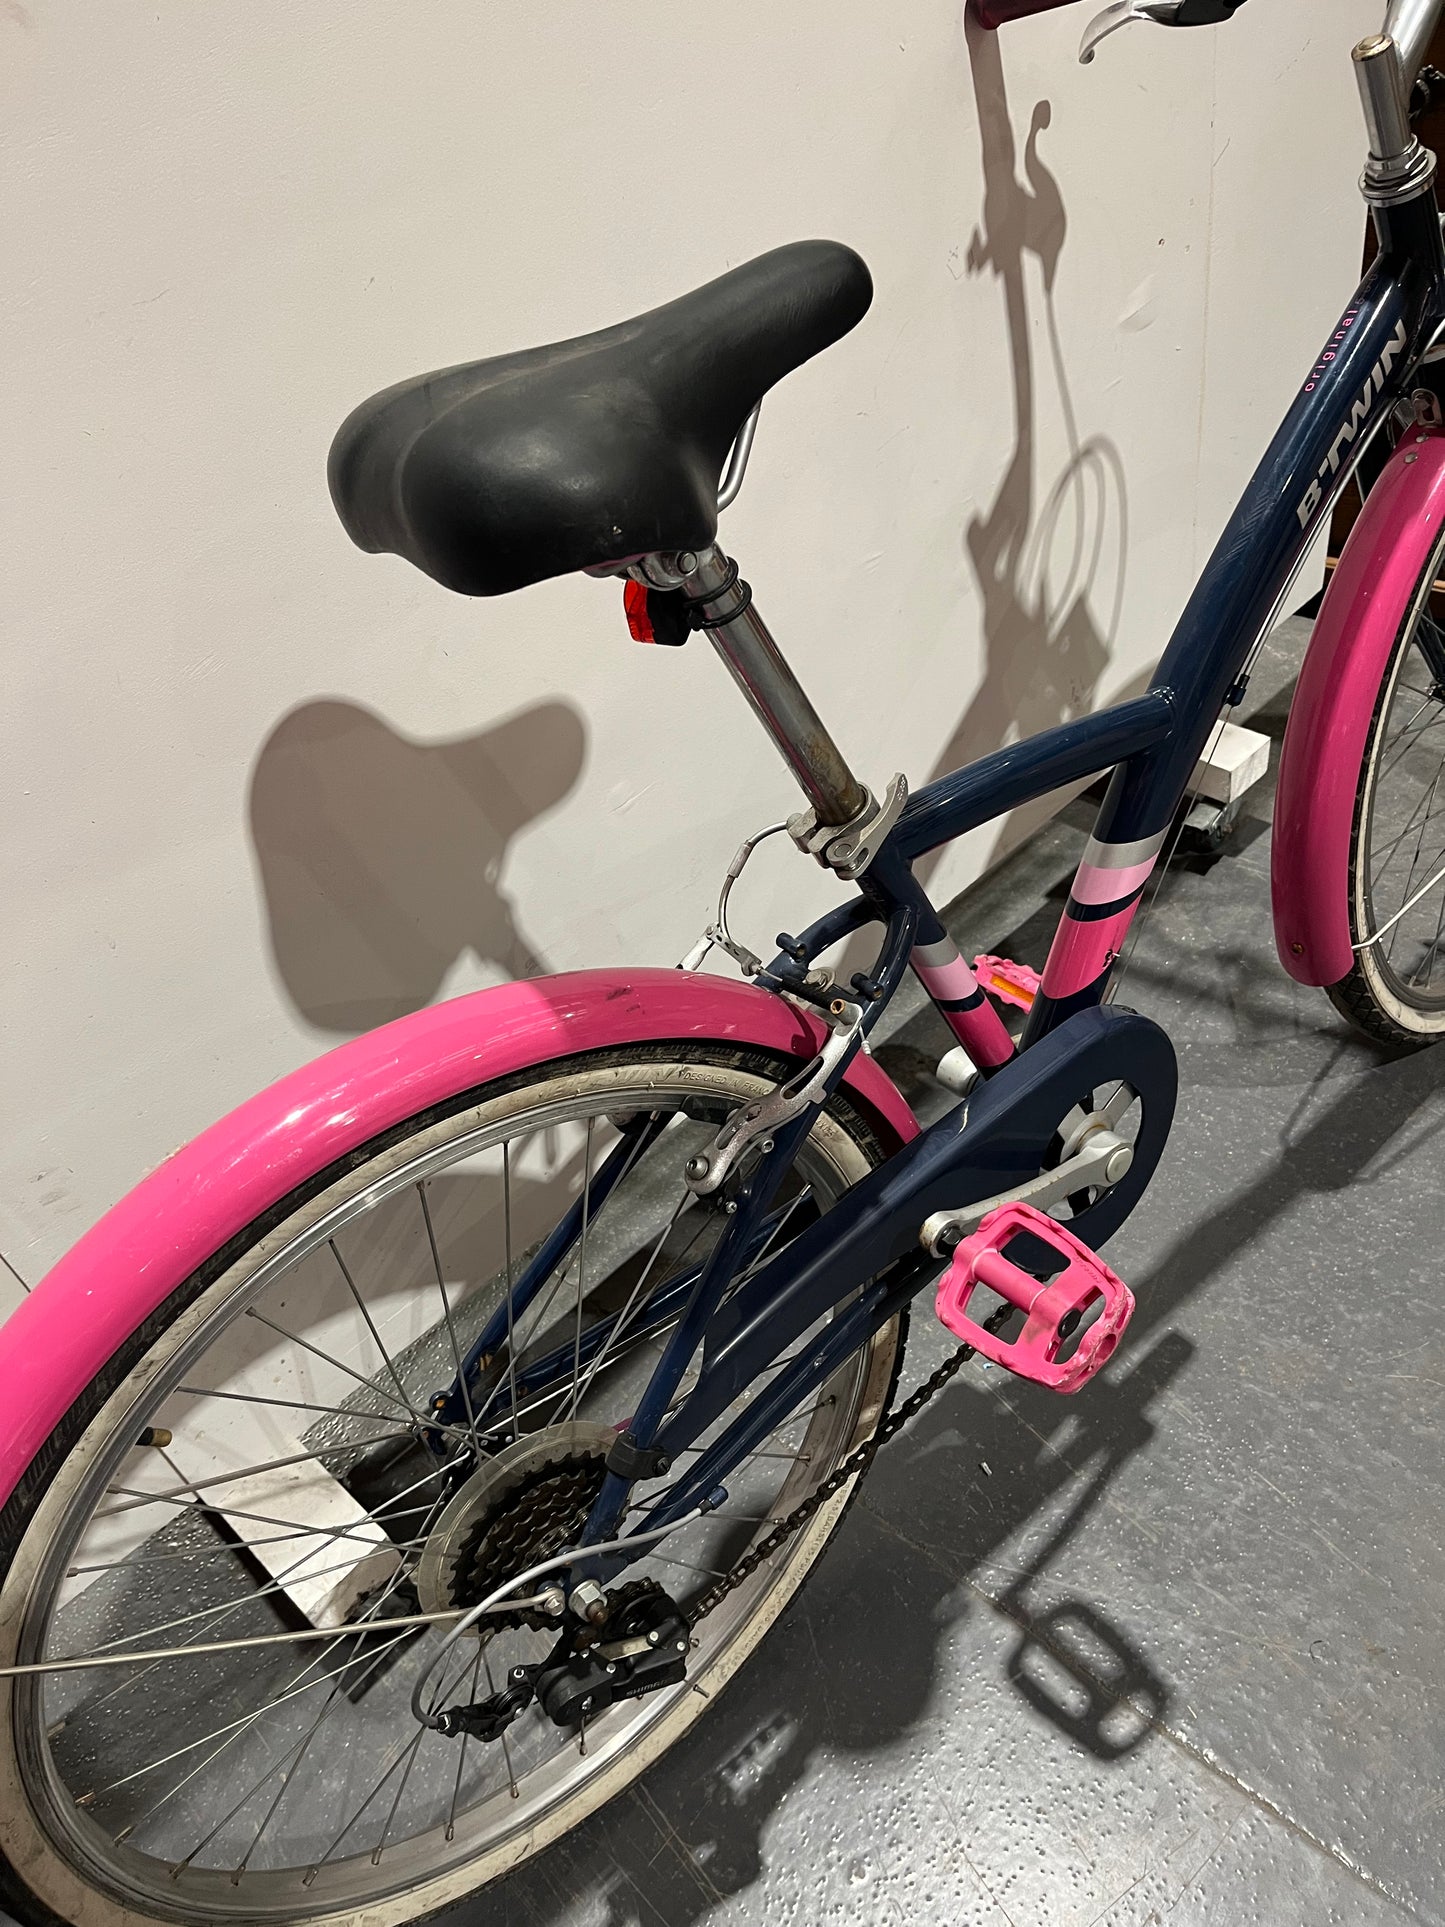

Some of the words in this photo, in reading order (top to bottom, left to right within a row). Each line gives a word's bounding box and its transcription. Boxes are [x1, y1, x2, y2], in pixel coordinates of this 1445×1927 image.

[1304, 309, 1358, 393] original
[1297, 319, 1407, 530] B'TWIN
[741, 1081, 771, 1096] FRANC
[626, 1679, 670, 1695] SHIMA
